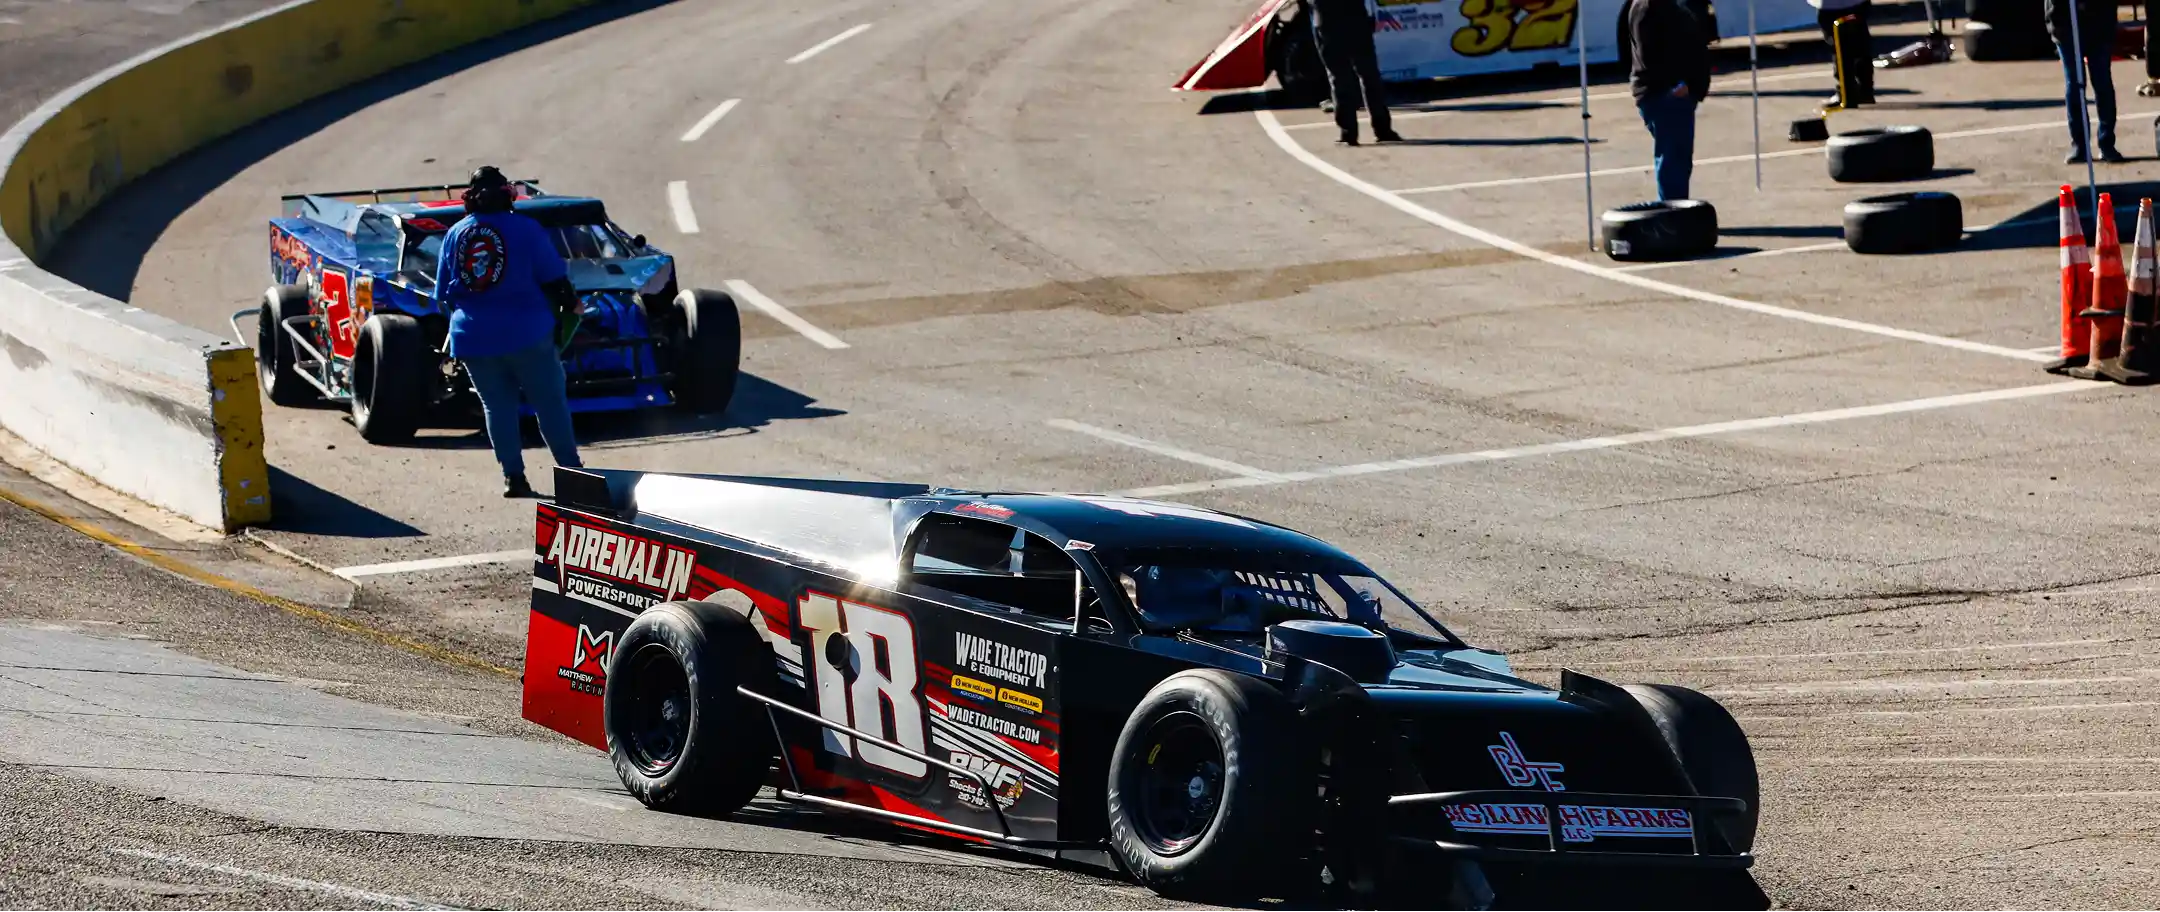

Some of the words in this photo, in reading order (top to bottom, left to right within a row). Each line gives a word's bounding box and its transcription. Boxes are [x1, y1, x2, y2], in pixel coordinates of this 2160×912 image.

[1451, 0, 1578, 57] 32
[321, 268, 356, 361] 2
[547, 521, 695, 602] ADRENALIN
[567, 577, 661, 609] POWERSPORTS
[955, 631, 993, 667] WADE
[994, 641, 1048, 690] TRACTOR
[558, 667, 593, 683] MATTHEW
[799, 591, 928, 778] 18
[970, 661, 978, 672] &
[979, 662, 1031, 687] EQUIPMENT
[571, 680, 605, 696] RACIN
[972, 683, 993, 695] HOLLAND
[1004, 702, 1035, 716] CONSTRUCTION
[1019, 696, 1040, 708] HOLLAND
[948, 704, 1041, 745] WADETRACTOR.COM
[949, 779, 976, 794] Shocks
[1482, 804, 1584, 827] LUNH
[1584, 806, 1692, 829] FARMS
